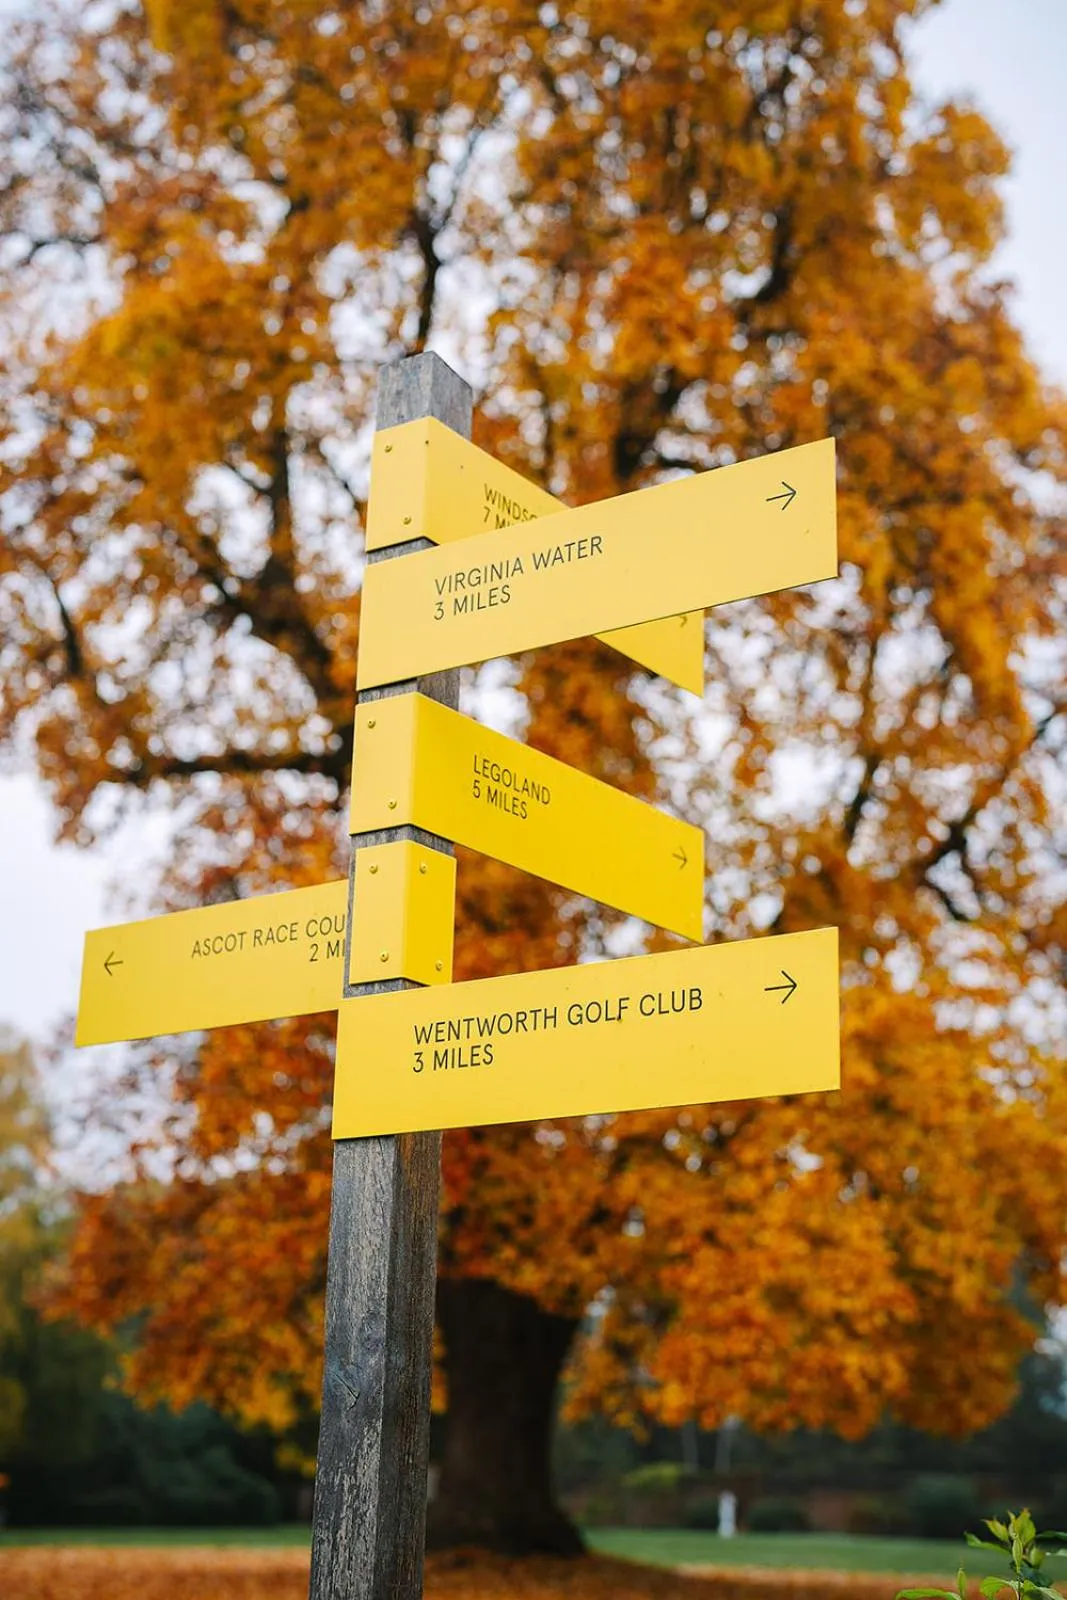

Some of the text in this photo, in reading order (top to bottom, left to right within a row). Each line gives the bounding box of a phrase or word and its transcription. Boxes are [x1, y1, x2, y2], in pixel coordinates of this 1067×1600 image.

[483, 505, 491, 523] 7
[484, 483, 538, 522] WINDS
[434, 535, 603, 596] VIRGINIA WATER
[433, 585, 511, 621] 3 MILES
[473, 779, 528, 819] 5 MILES
[474, 754, 551, 805] LEGOLAND
[191, 913, 346, 959] ASCOT RACE COU
[309, 943, 319, 962] 2
[414, 988, 703, 1045] WENTWORTH GOLF CLUB
[412, 1043, 494, 1073] 3 MILES
